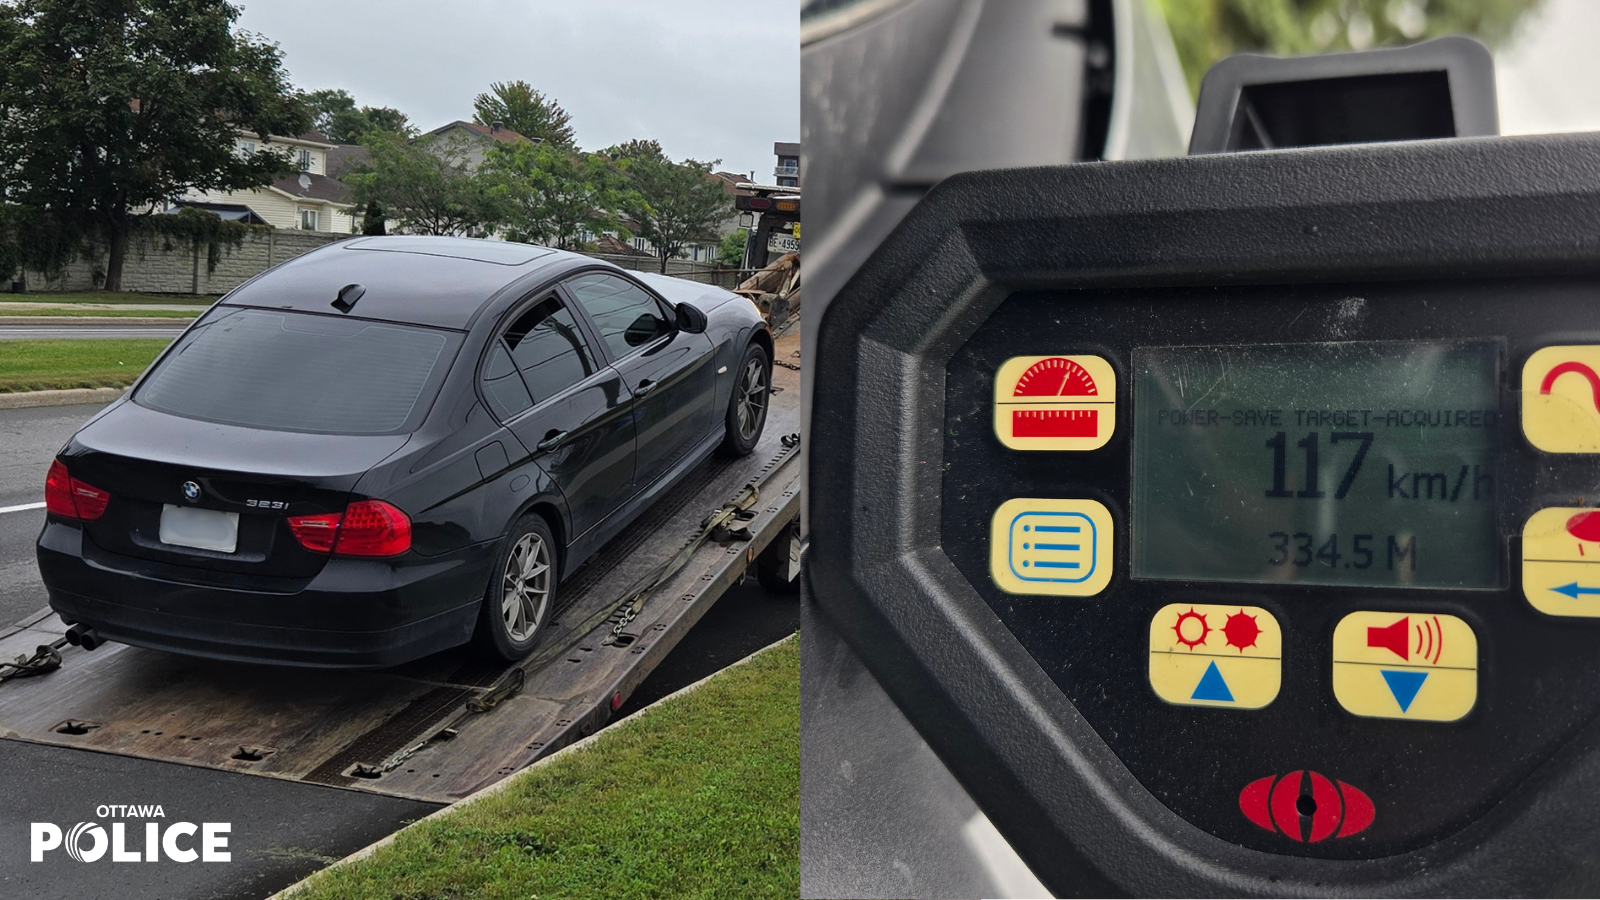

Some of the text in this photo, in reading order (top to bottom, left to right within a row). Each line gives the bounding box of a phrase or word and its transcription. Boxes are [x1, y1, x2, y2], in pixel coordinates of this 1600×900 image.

[1157, 409, 1497, 427] POWER-SAVE TARGET-ACQUIRED
[1264, 431, 1494, 502] 117 km/h
[1268, 531, 1417, 571] 334.5 M
